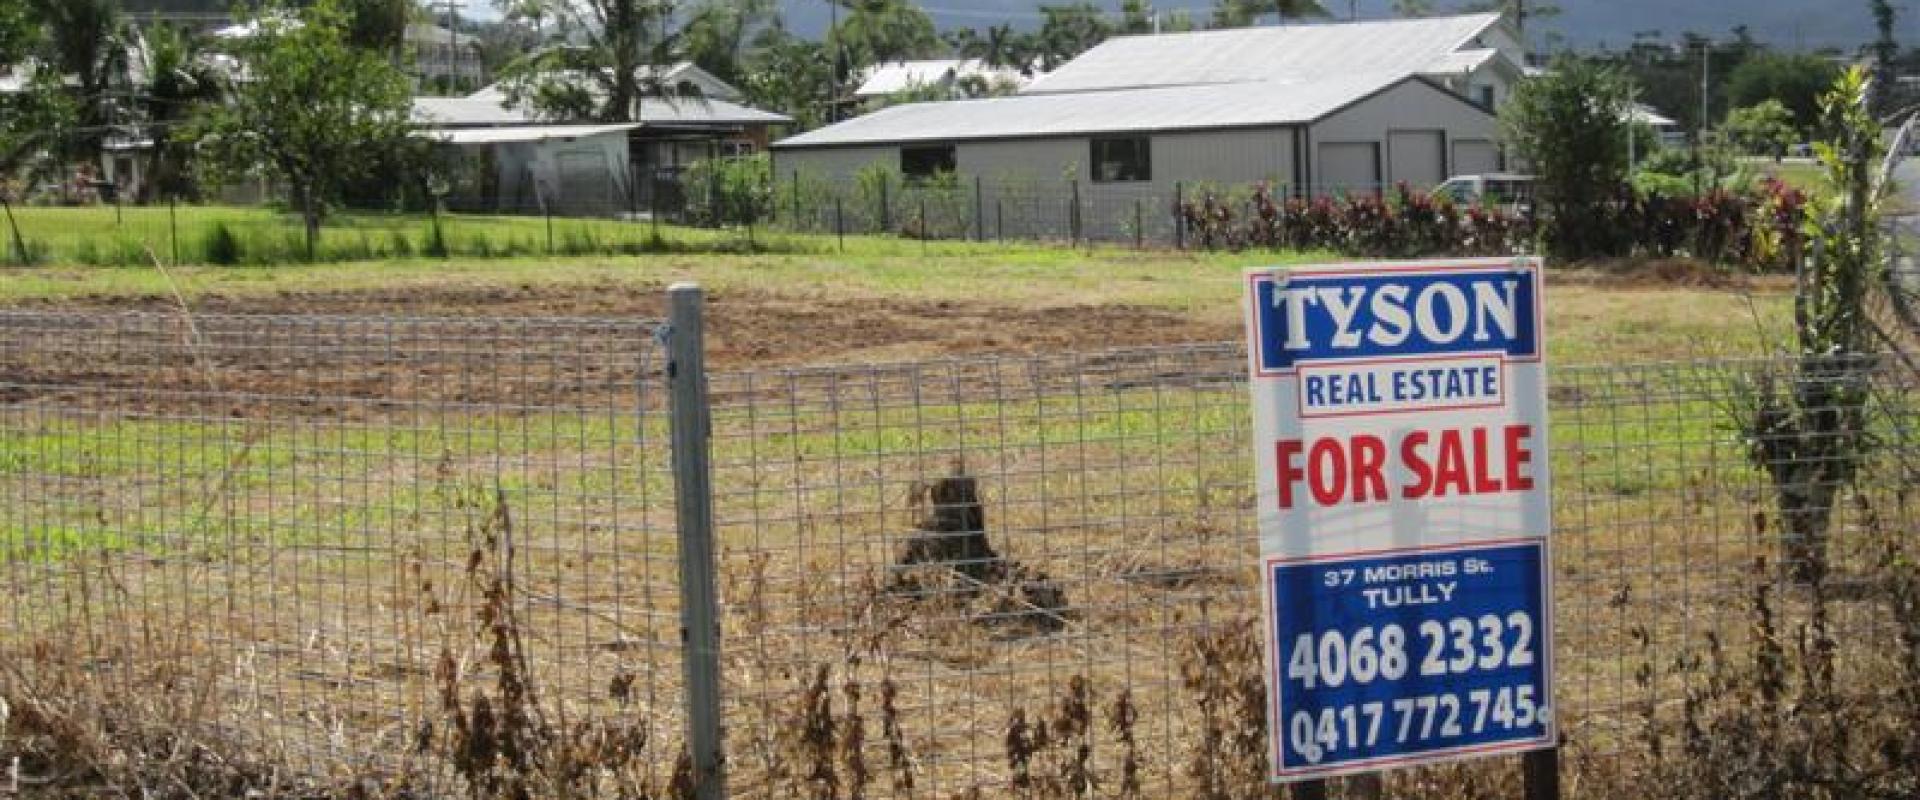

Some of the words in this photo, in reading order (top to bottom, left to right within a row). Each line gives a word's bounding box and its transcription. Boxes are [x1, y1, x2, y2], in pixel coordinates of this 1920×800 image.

[1274, 280, 1518, 349] TYSON
[1306, 372, 1381, 406] REAL
[1392, 366, 1497, 400] ESTATE
[1275, 434, 1388, 509] FOR
[1400, 424, 1534, 500] SALE
[1324, 569, 1354, 586] 37
[1364, 560, 1457, 583] MORRIS
[1362, 581, 1457, 609] TULLY
[1289, 624, 1408, 689] 4068
[1420, 611, 1534, 676] 2332
[1290, 703, 1383, 755] 0417
[1394, 694, 1461, 743] 772
[1470, 684, 1537, 733] 745
